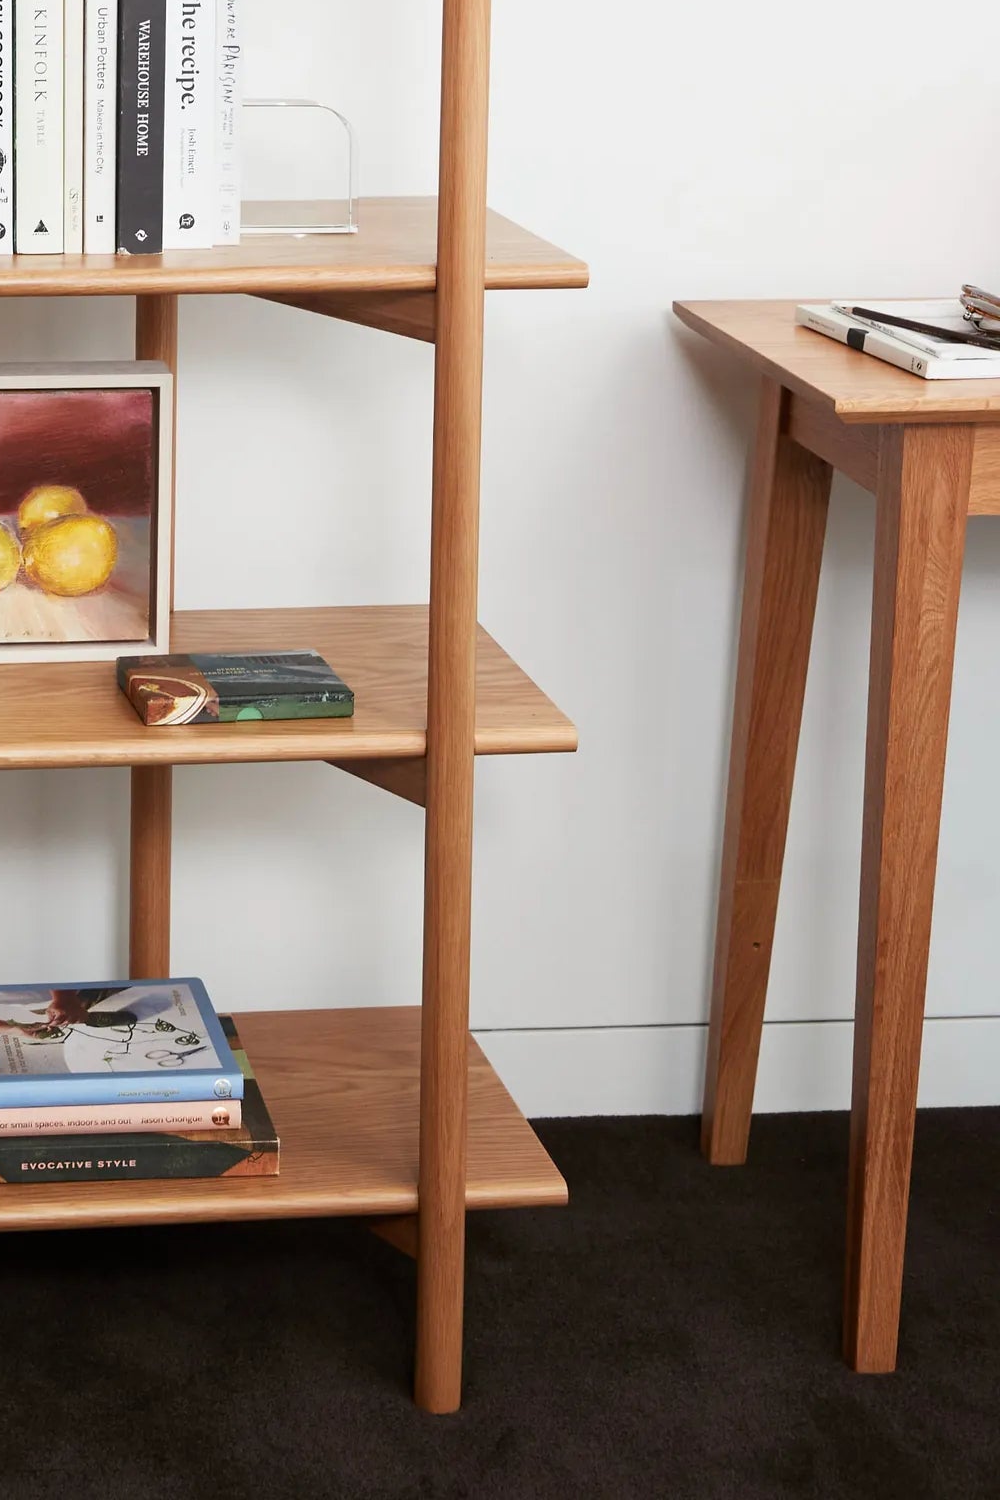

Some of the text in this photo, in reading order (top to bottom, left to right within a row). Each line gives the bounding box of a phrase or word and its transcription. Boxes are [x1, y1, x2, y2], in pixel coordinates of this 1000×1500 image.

[34, 9, 48, 102] KINFOLK
[96, 7, 108, 90] Urban Potters
[175, 36, 200, 110] recipe.
[219, 45, 241, 104] PARISIAN
[136, 19, 151, 156] WAREHOUSE HOME
[36, 110, 46, 146] TABLE
[94, 99, 105, 175] Makers in the City
[187, 128, 197, 146] Josh
[10, 1120, 33, 1129] small
[67, 1118, 99, 1127] indoors
[100, 1117, 116, 1126] and
[117, 1116, 132, 1125] out
[140, 1115, 163, 1124] Jason
[21, 1159, 137, 1171] EVOCATIVE STYLE
